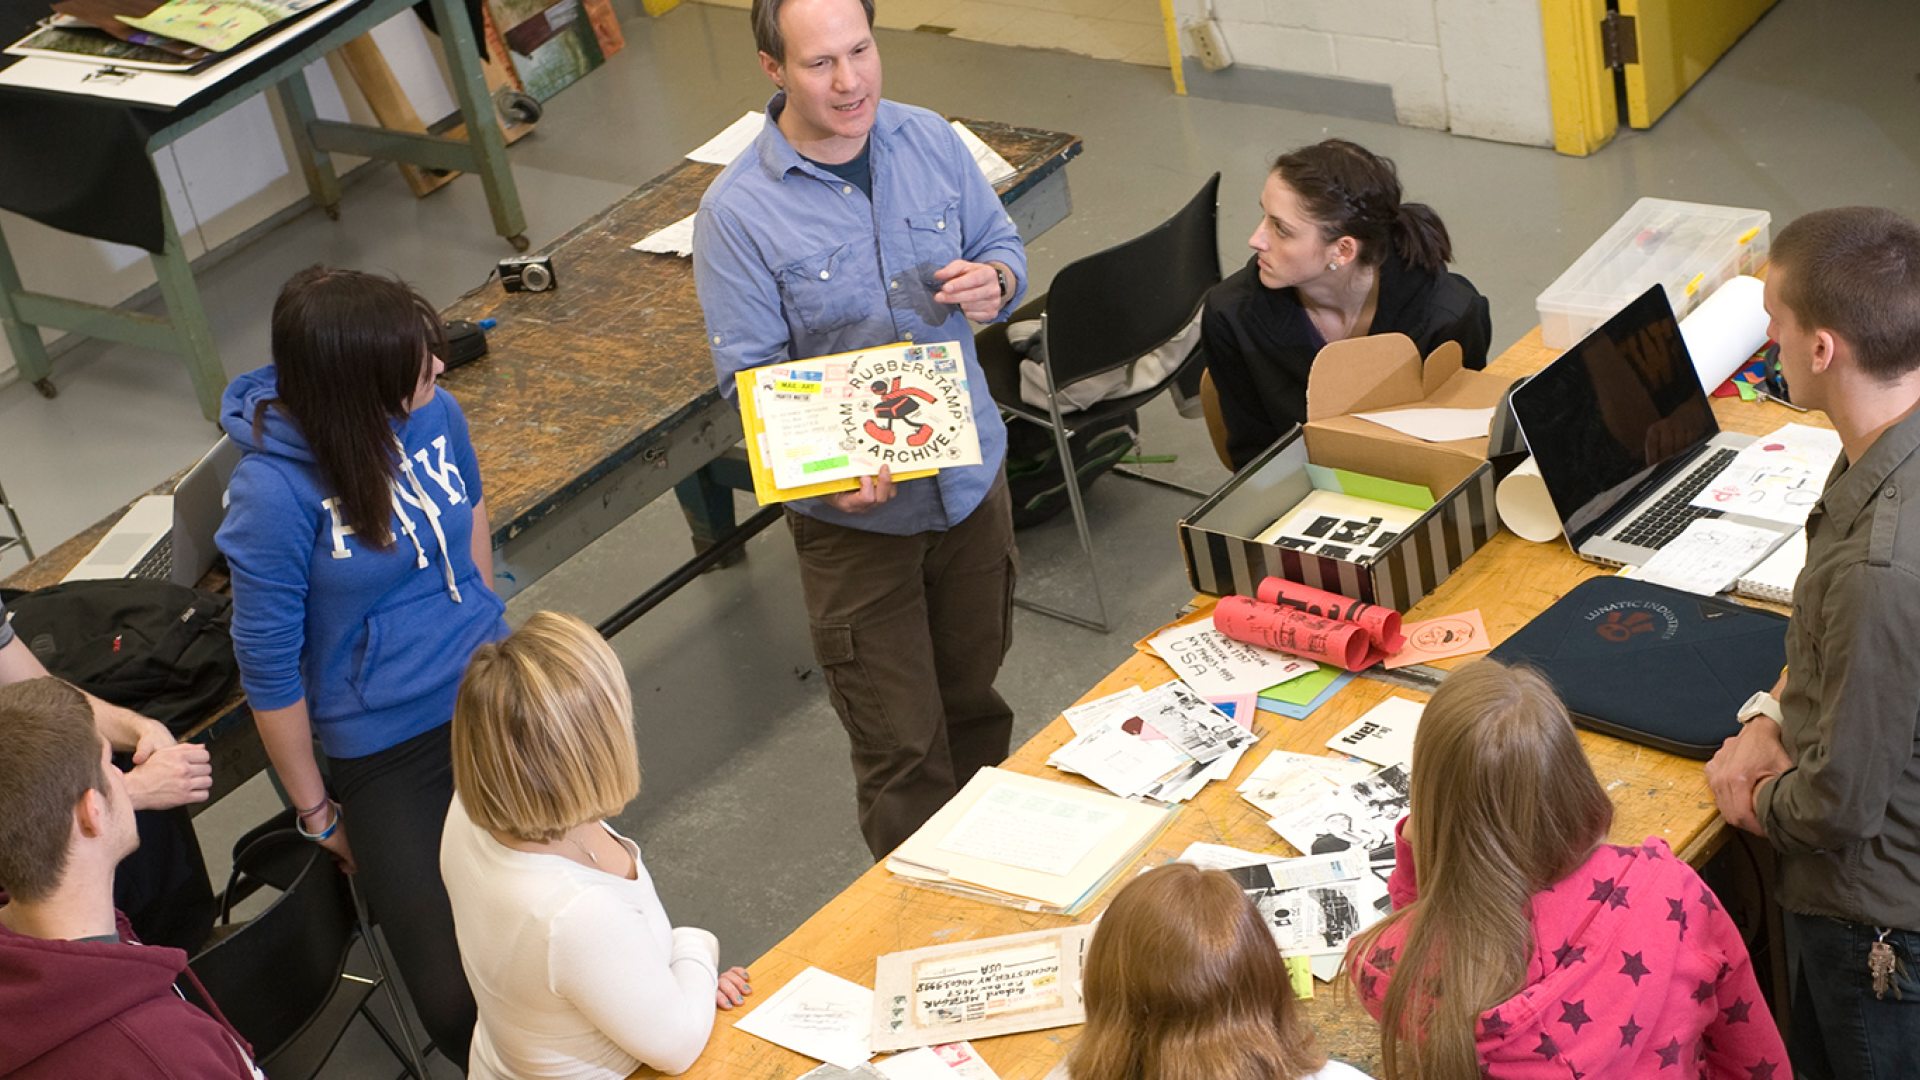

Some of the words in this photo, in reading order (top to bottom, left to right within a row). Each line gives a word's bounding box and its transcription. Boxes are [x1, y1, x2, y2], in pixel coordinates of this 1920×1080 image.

[849, 360, 962, 420] RUBBERSTAMP
[868, 434, 950, 463] ARCHIVE
[1584, 600, 1641, 621] LUNATIC
[1170, 639, 1208, 676] USA
[1341, 721, 1380, 745] fuel
[981, 963, 1002, 975] USA
